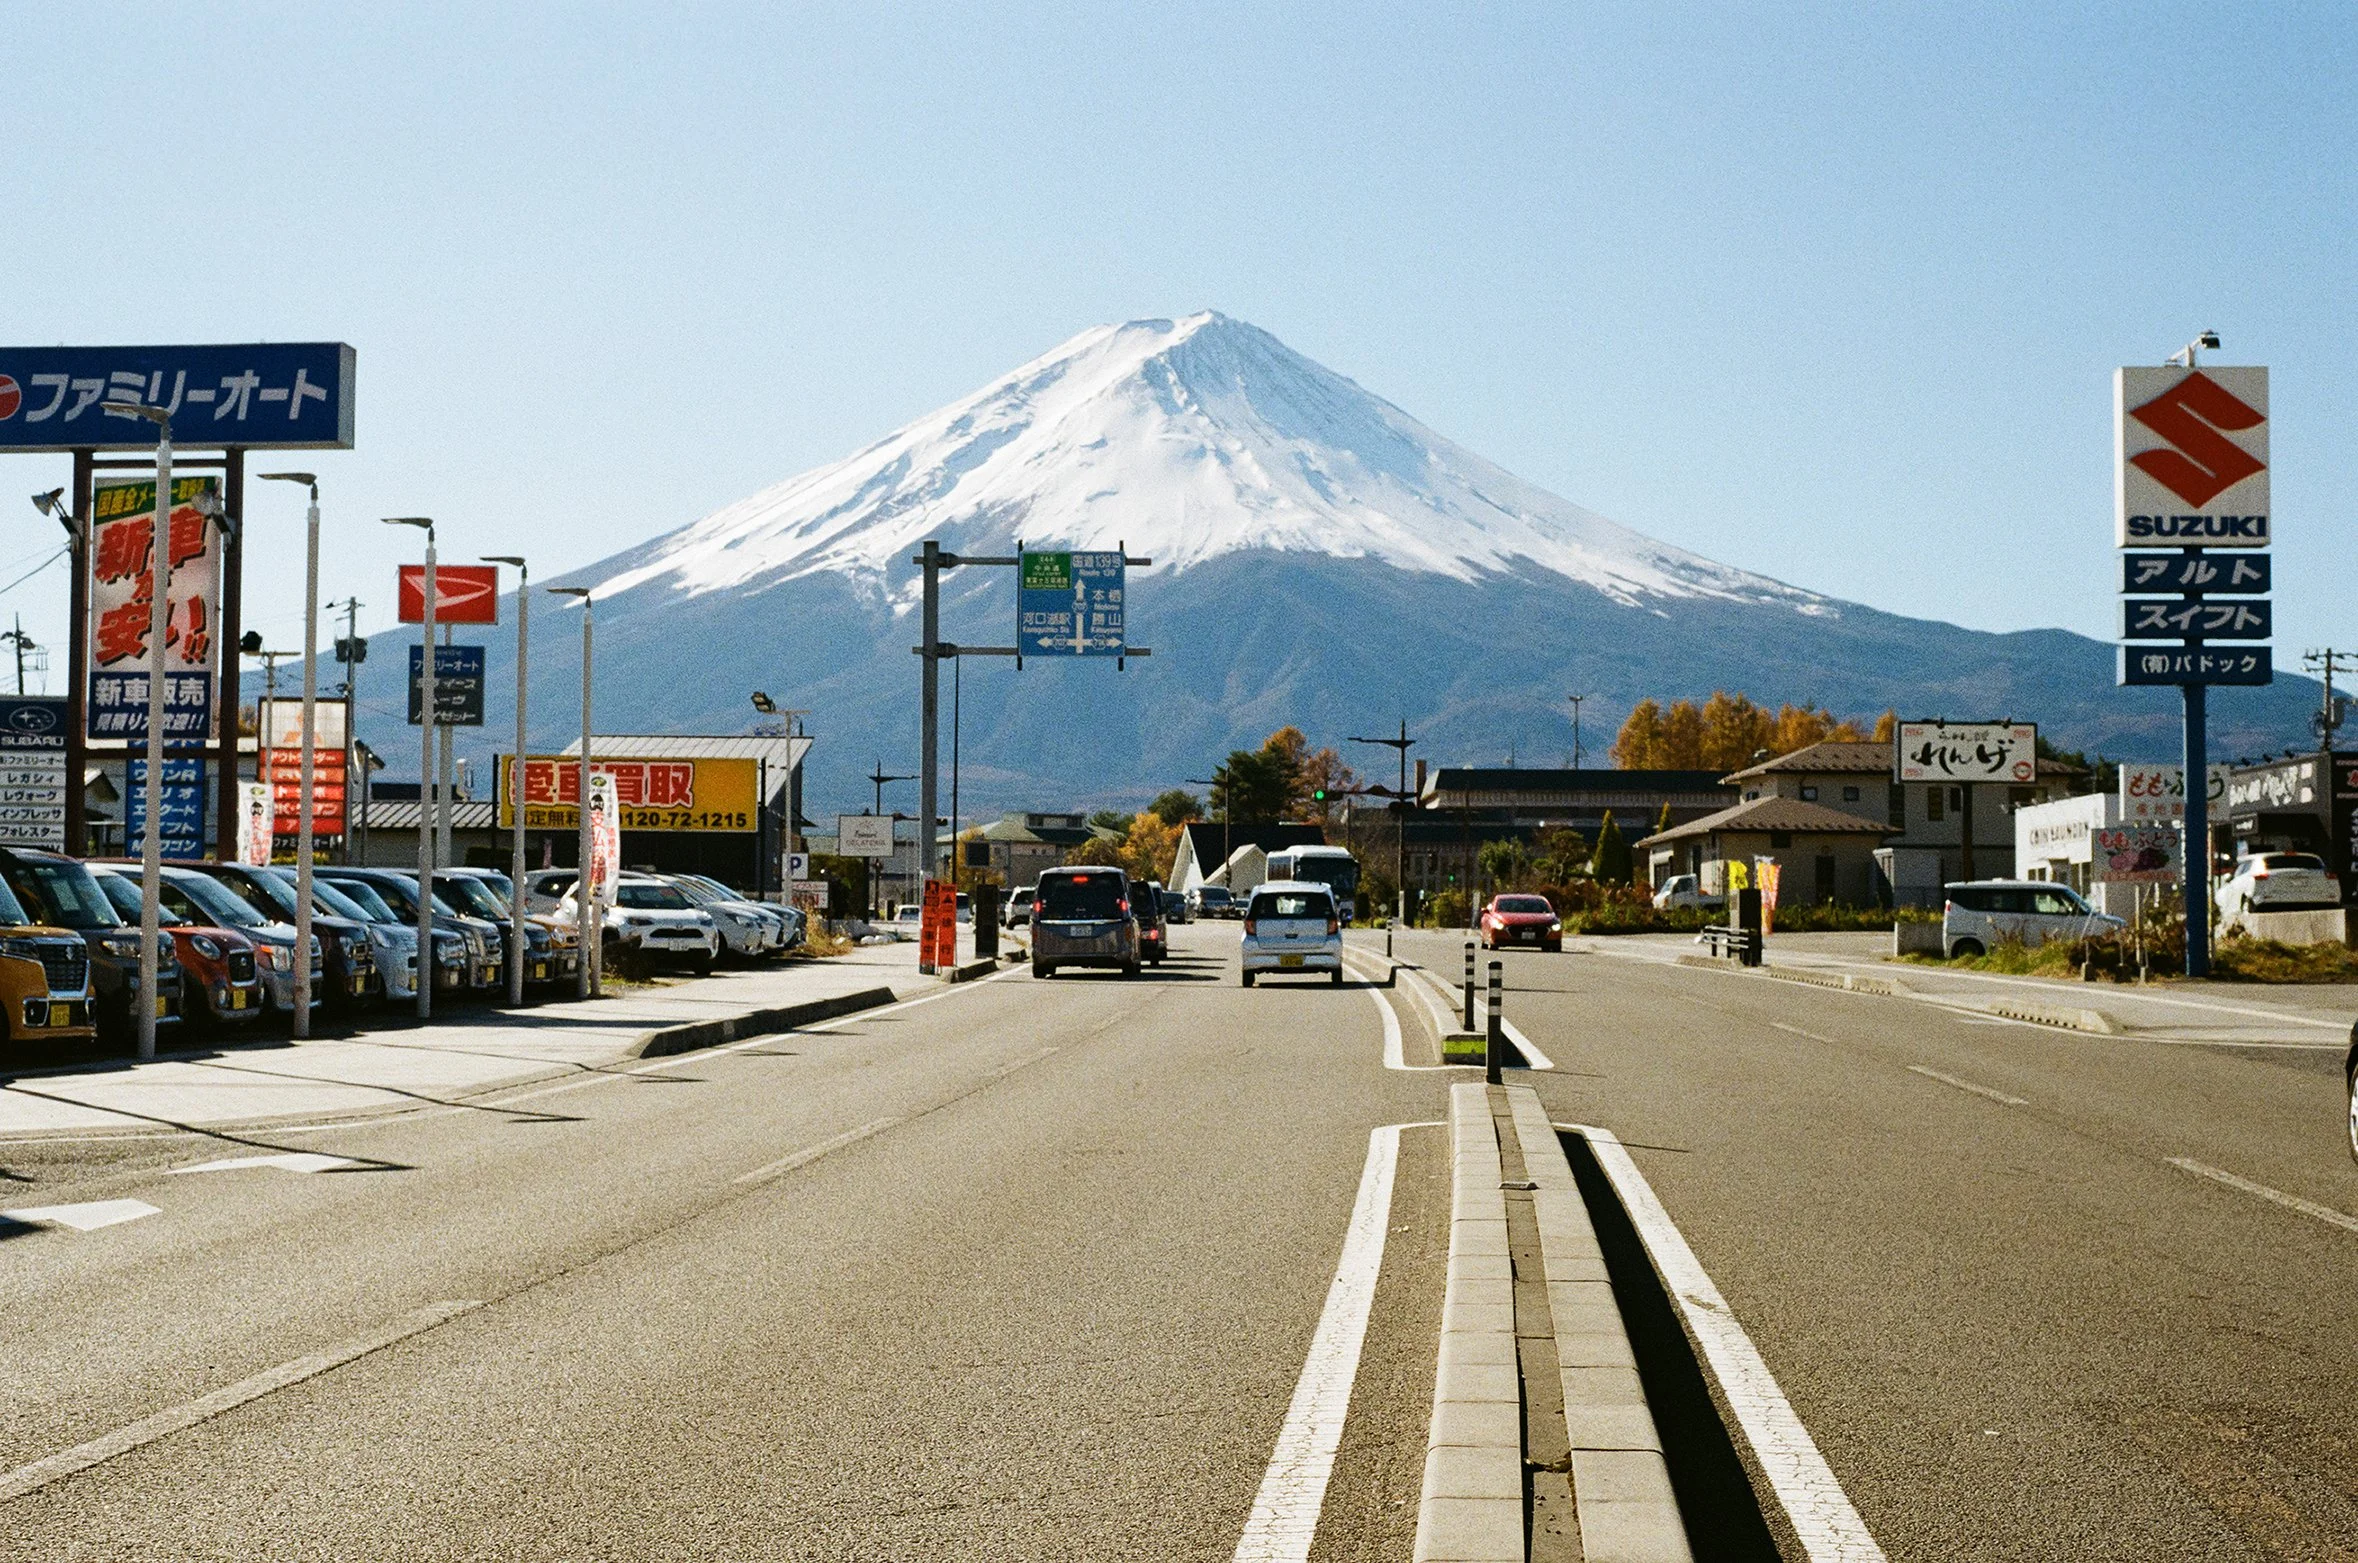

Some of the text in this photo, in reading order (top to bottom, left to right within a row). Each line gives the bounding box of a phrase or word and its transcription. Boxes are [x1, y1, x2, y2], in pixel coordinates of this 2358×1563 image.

[25, 368, 328, 423] ファミリーオート
[2127, 515, 2267, 538] SUZUKI
[2134, 558, 2263, 584] アルト
[2135, 605, 2264, 630] スイフト
[1, 735, 65, 747] SUBARU
[1910, 738, 2006, 777] れんげ
[790, 857, 802, 875] P
